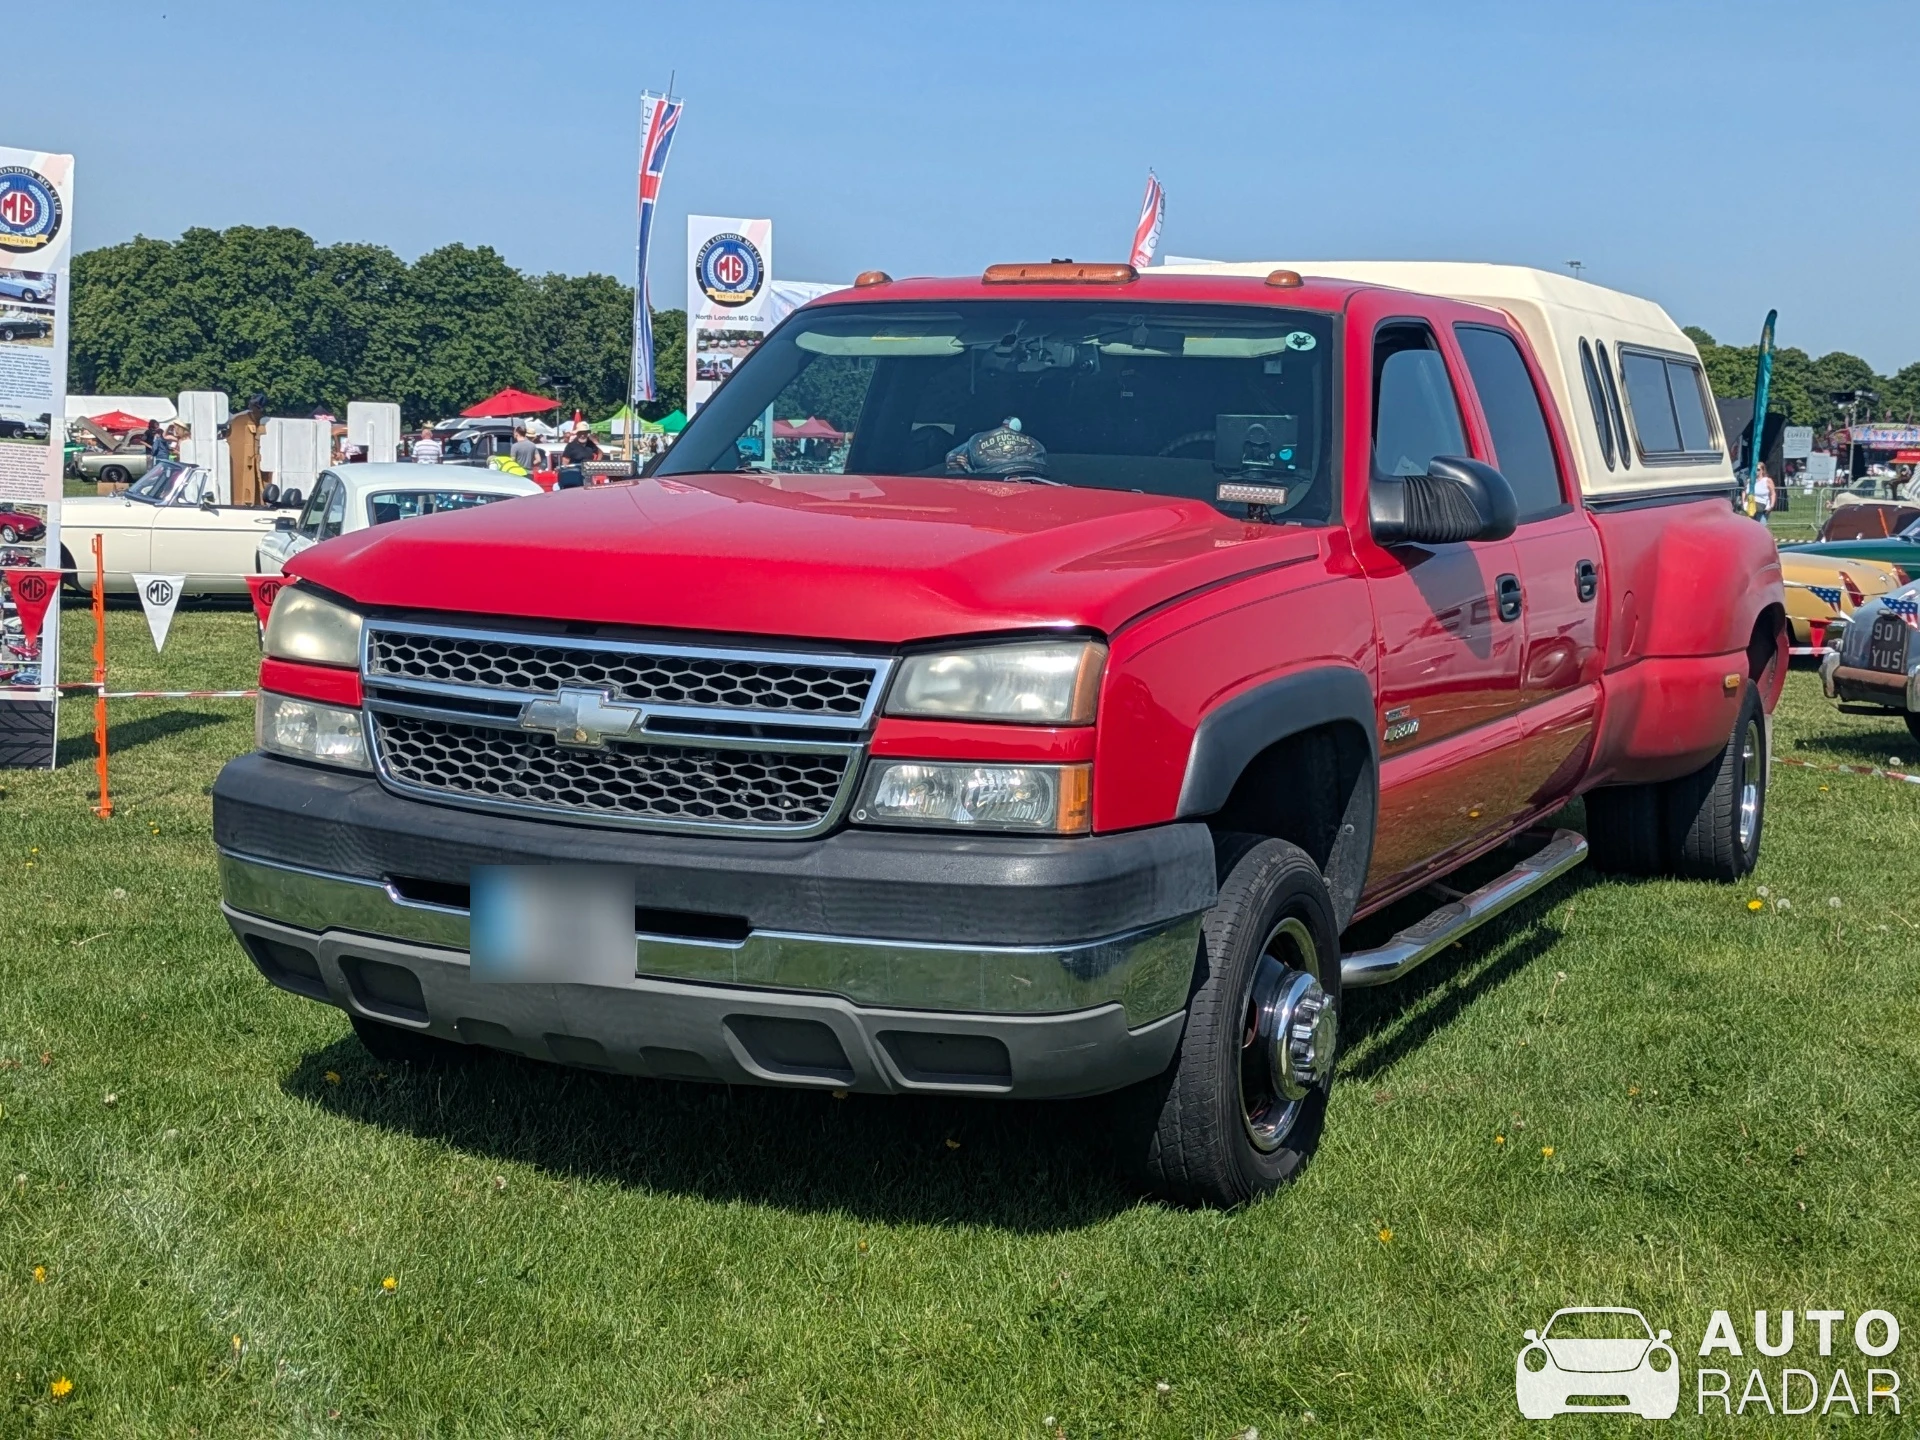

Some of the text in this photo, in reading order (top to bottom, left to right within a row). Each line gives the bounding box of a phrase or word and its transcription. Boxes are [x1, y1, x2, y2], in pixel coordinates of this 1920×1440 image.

[0, 167, 62, 215] ONDON MG CLUB
[2, 192, 34, 224] MG
[696, 233, 764, 273] NORTH LONDON MG CLUB
[718, 255, 743, 283] MG
[695, 313, 713, 321] North
[714, 314, 738, 322] London
[750, 315, 764, 323] Club
[981, 437, 995, 449] OLD
[21, 577, 45, 599] MG
[149, 582, 171, 604] MG
[1873, 622, 1902, 642] 901
[1872, 649, 1902, 670] YUS
